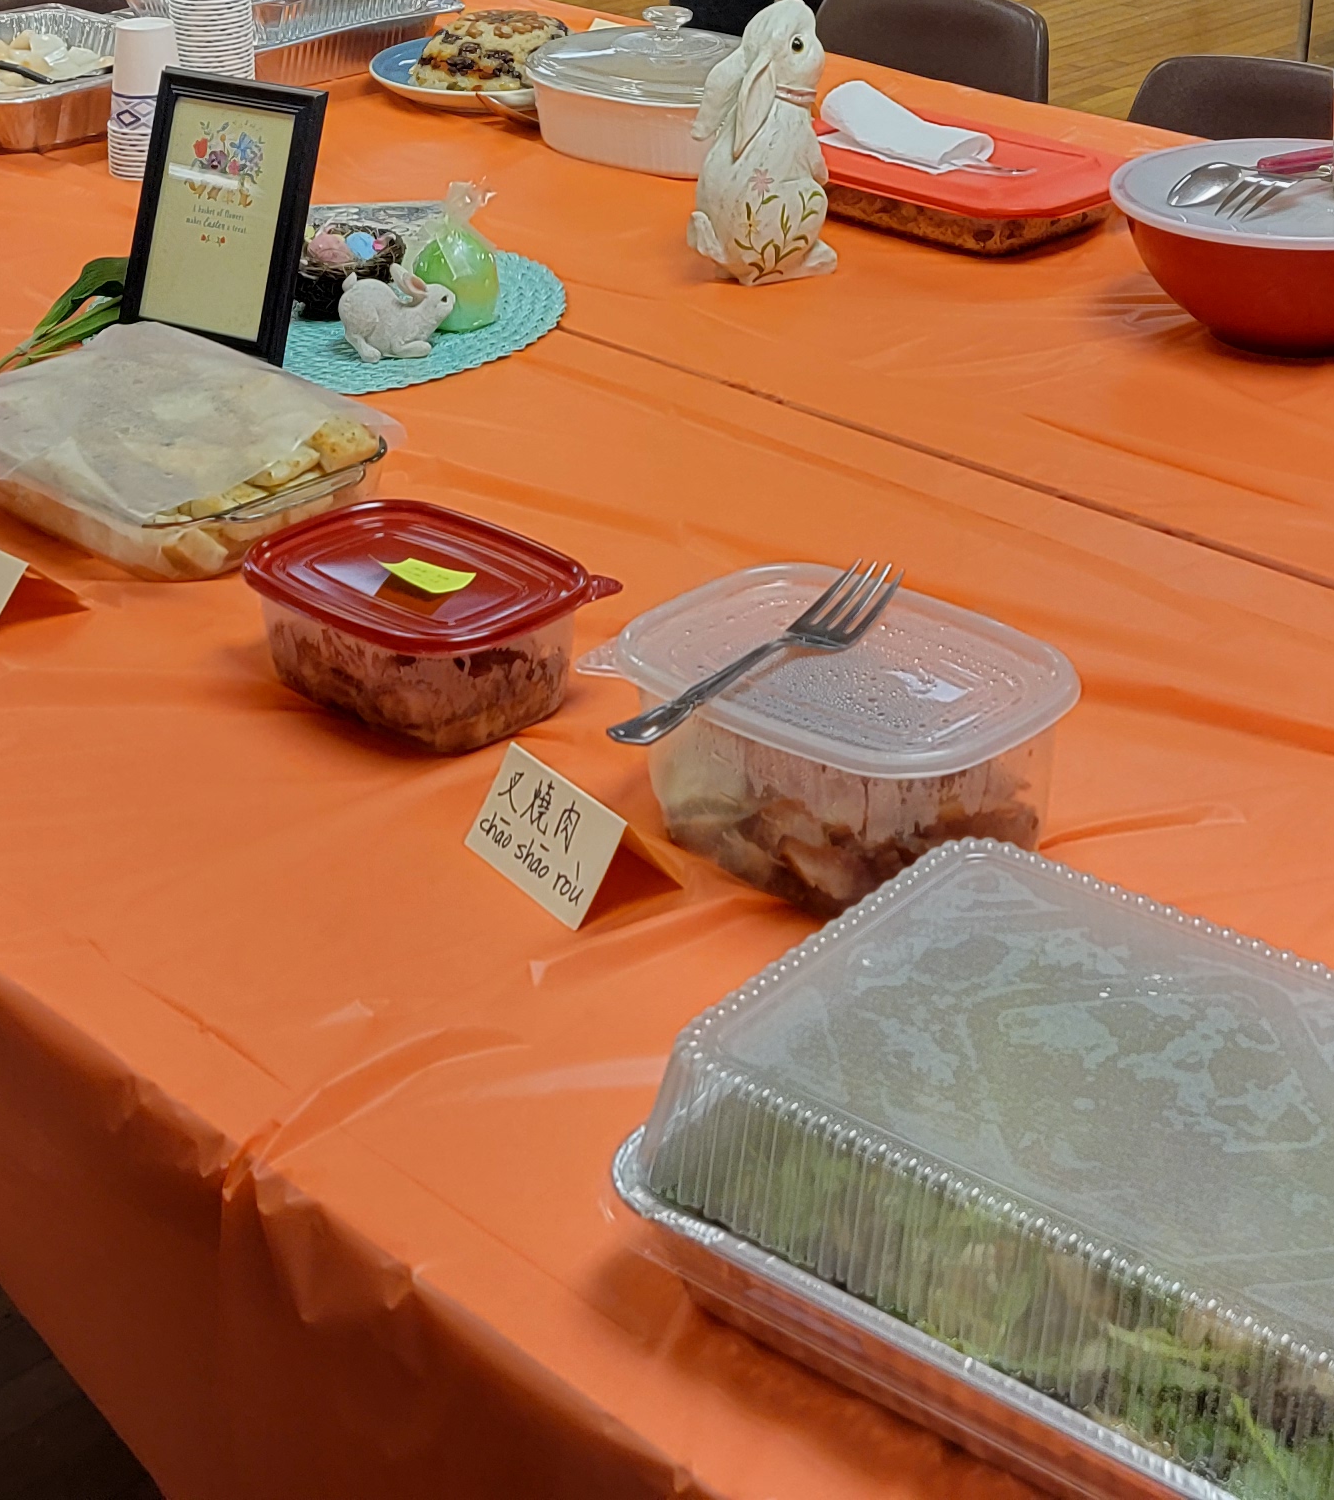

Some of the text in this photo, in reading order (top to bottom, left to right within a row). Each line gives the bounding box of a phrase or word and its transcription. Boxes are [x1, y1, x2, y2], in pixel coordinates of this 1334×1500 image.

[203, 217, 225, 230] Easter
[498, 771, 581, 855] 叉燒肉
